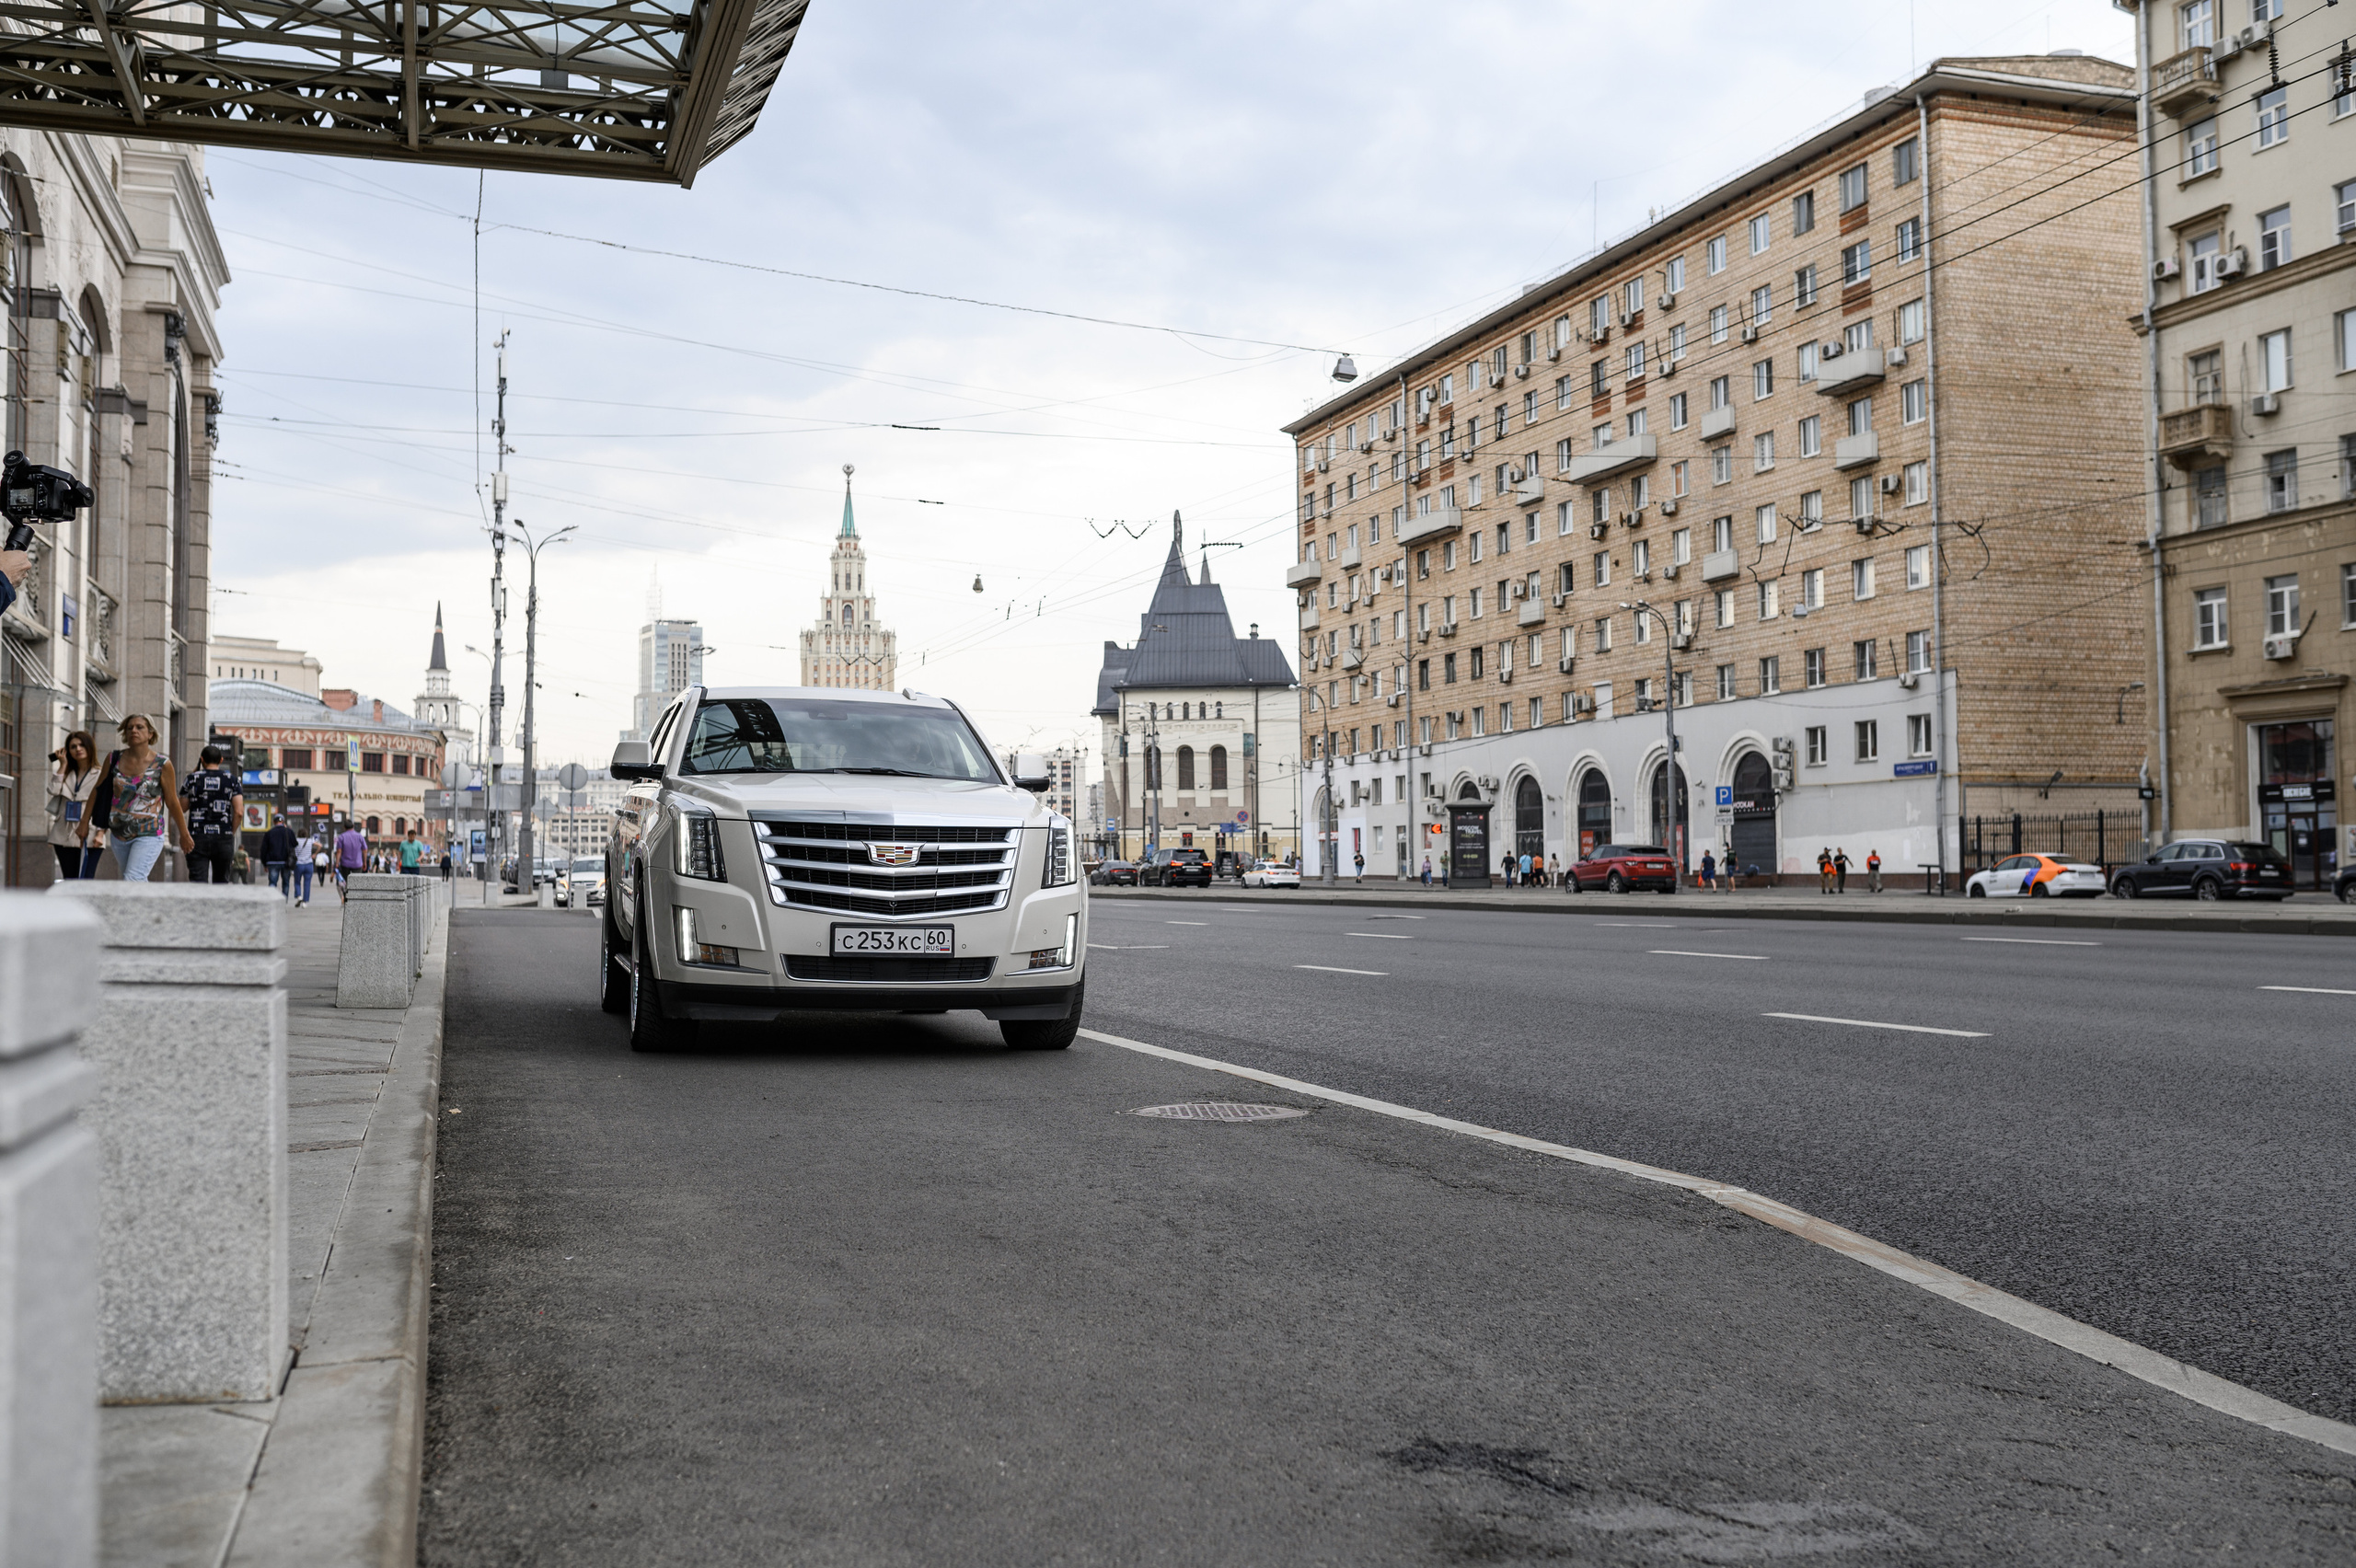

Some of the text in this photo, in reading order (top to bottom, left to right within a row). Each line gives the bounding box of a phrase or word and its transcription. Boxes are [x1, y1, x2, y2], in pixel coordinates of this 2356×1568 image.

[332, 791, 421, 802] ТЕААЛЬНО-КОНЦЕРТНЫЙ
[1719, 789, 1728, 803] P
[927, 931, 945, 945] 60
